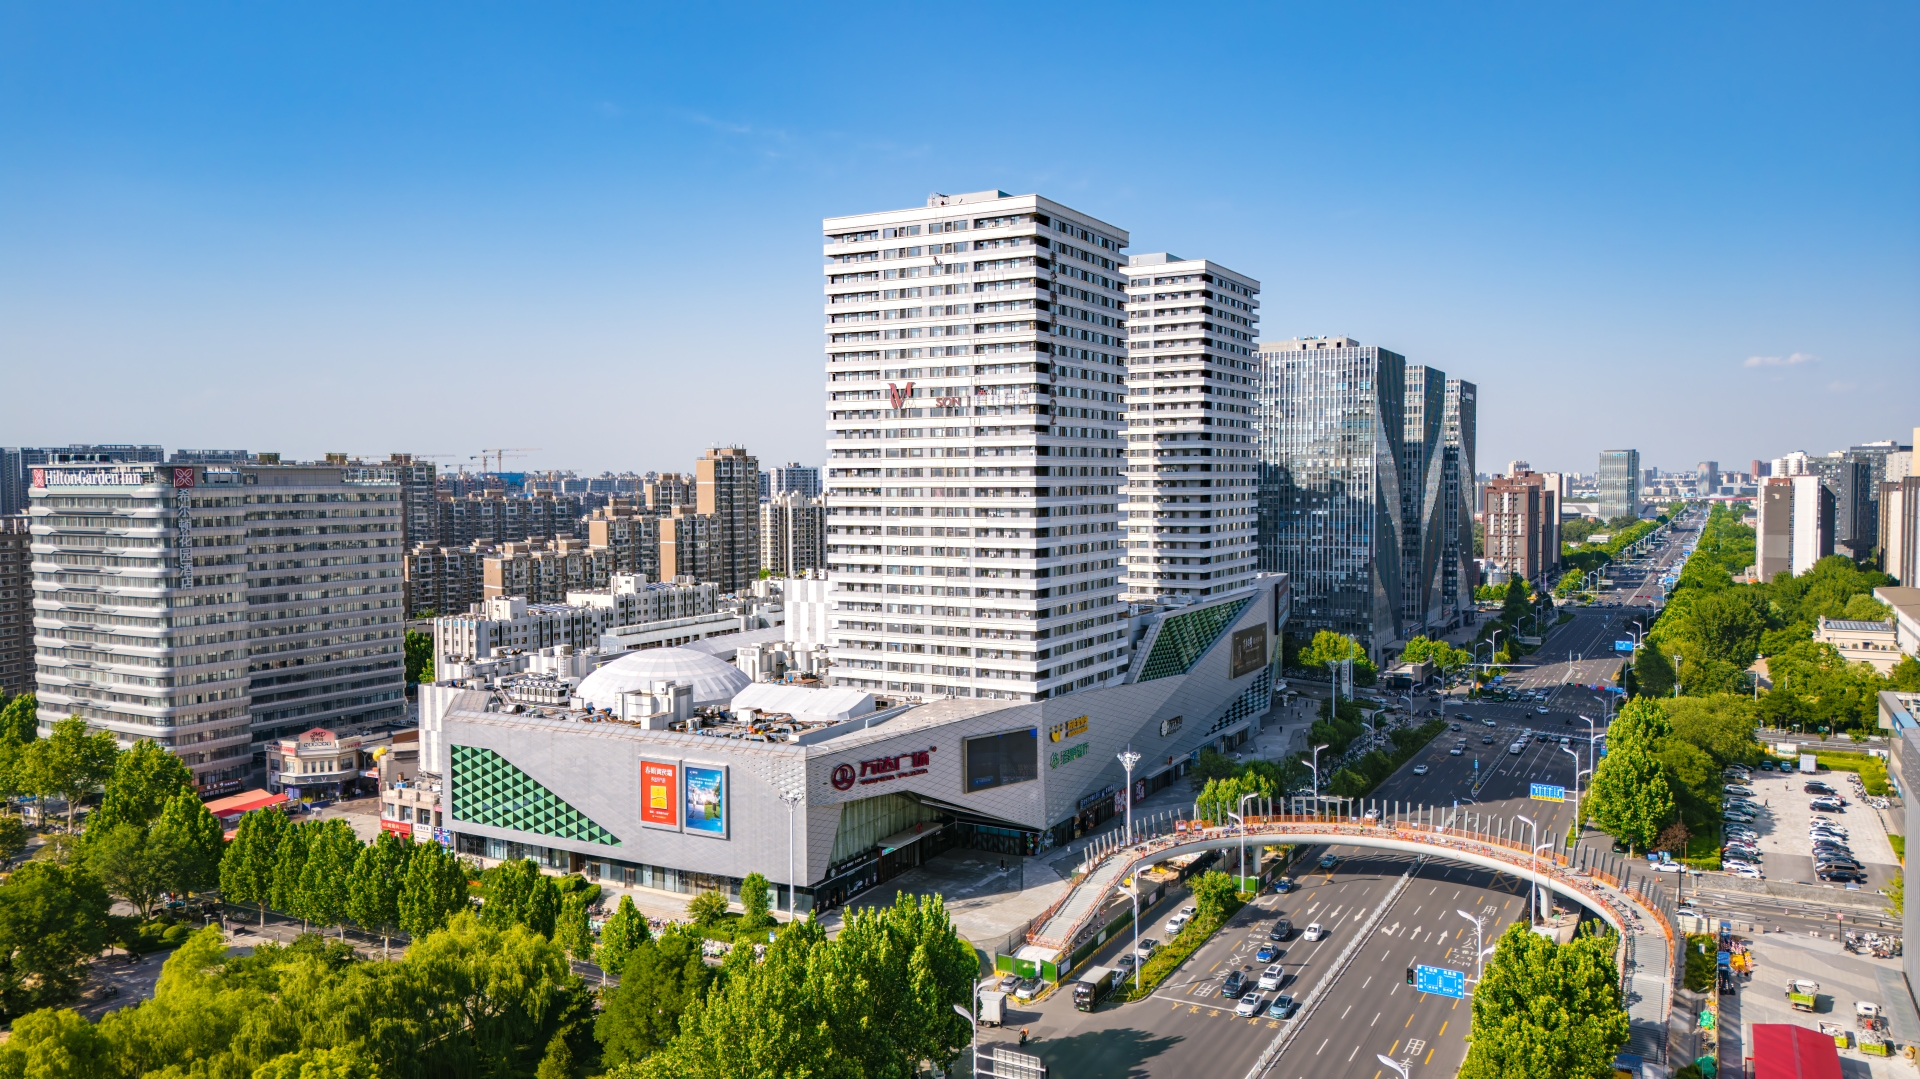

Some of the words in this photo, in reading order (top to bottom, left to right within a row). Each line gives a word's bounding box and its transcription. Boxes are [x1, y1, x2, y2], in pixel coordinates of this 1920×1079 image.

[44, 469, 77, 485] Hilton
[78, 469, 119, 485] Garden
[121, 469, 142, 485] Inn
[177, 488, 193, 590] 希尔顿花园酒店
[860, 750, 930, 777] 万达广场
